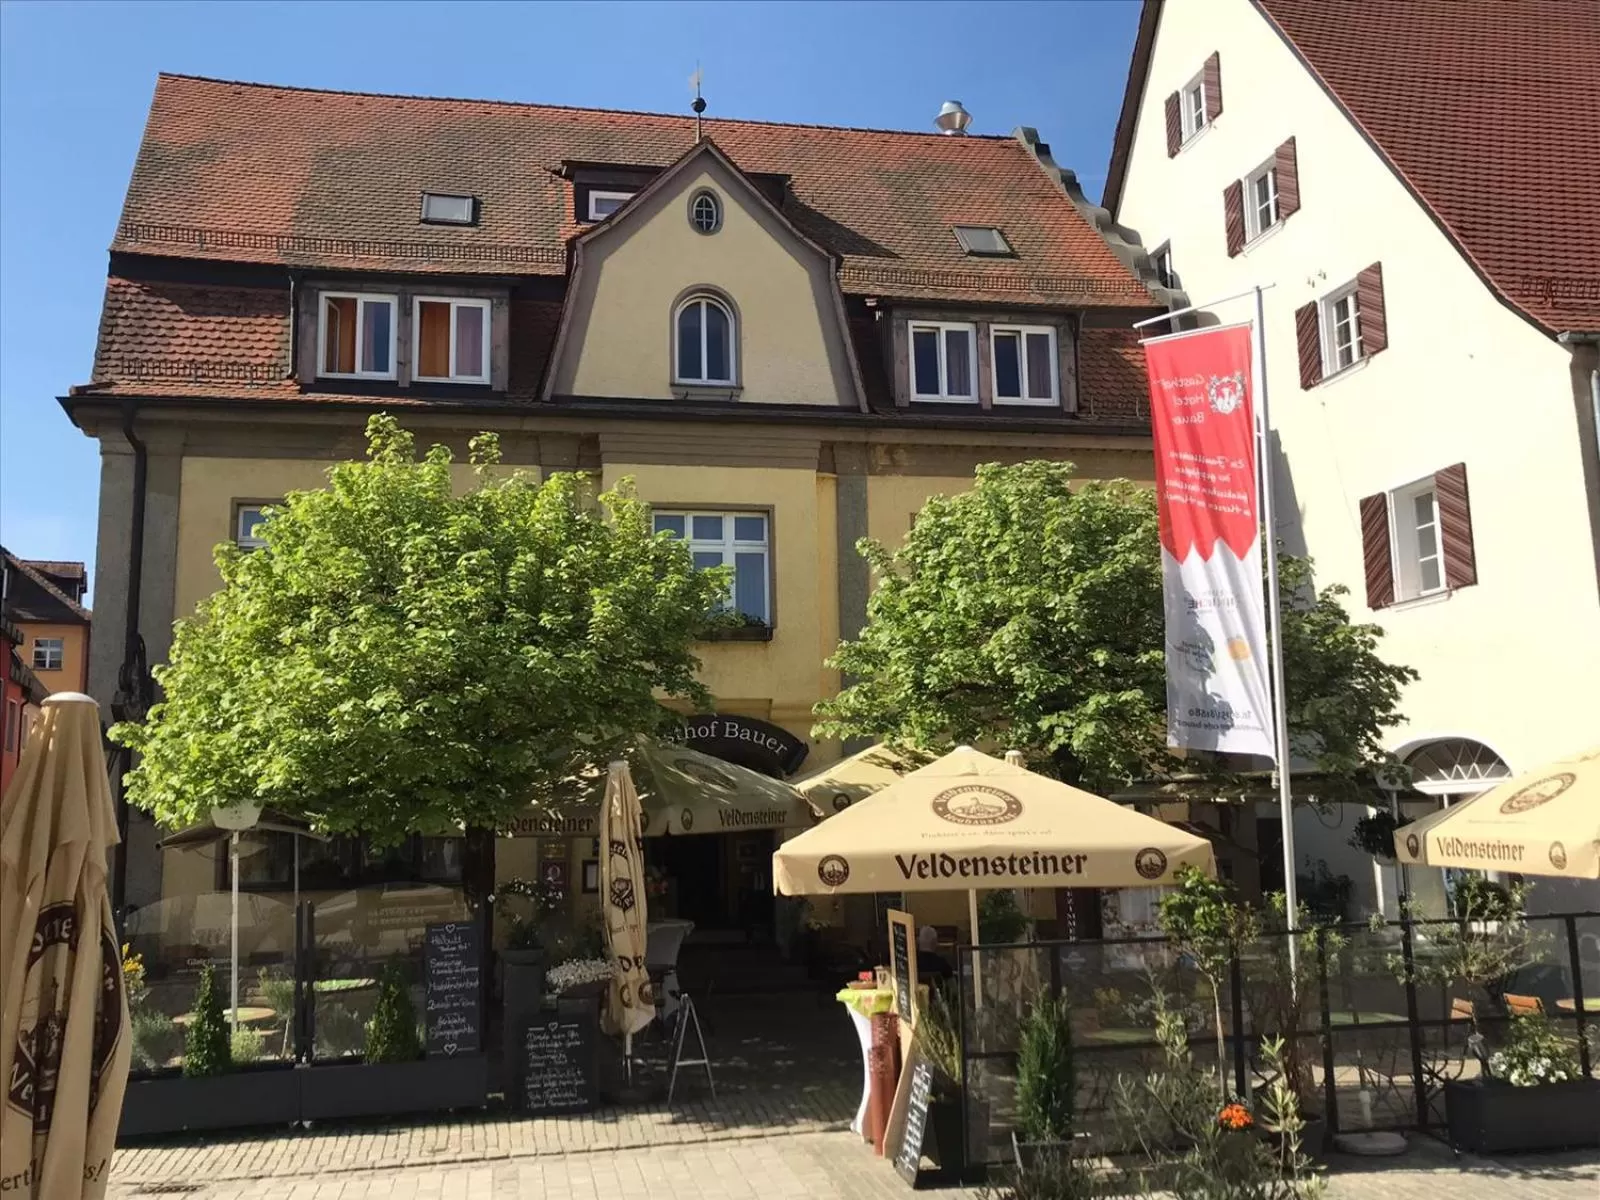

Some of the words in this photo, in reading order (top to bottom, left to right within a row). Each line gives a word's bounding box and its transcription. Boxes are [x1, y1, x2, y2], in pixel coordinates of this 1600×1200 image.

[723, 721, 788, 755] Bauer
[718, 807, 788, 828] Veldensteiner
[1436, 836, 1525, 862] Veldensteiner
[895, 850, 1088, 881] Veldensteiner
